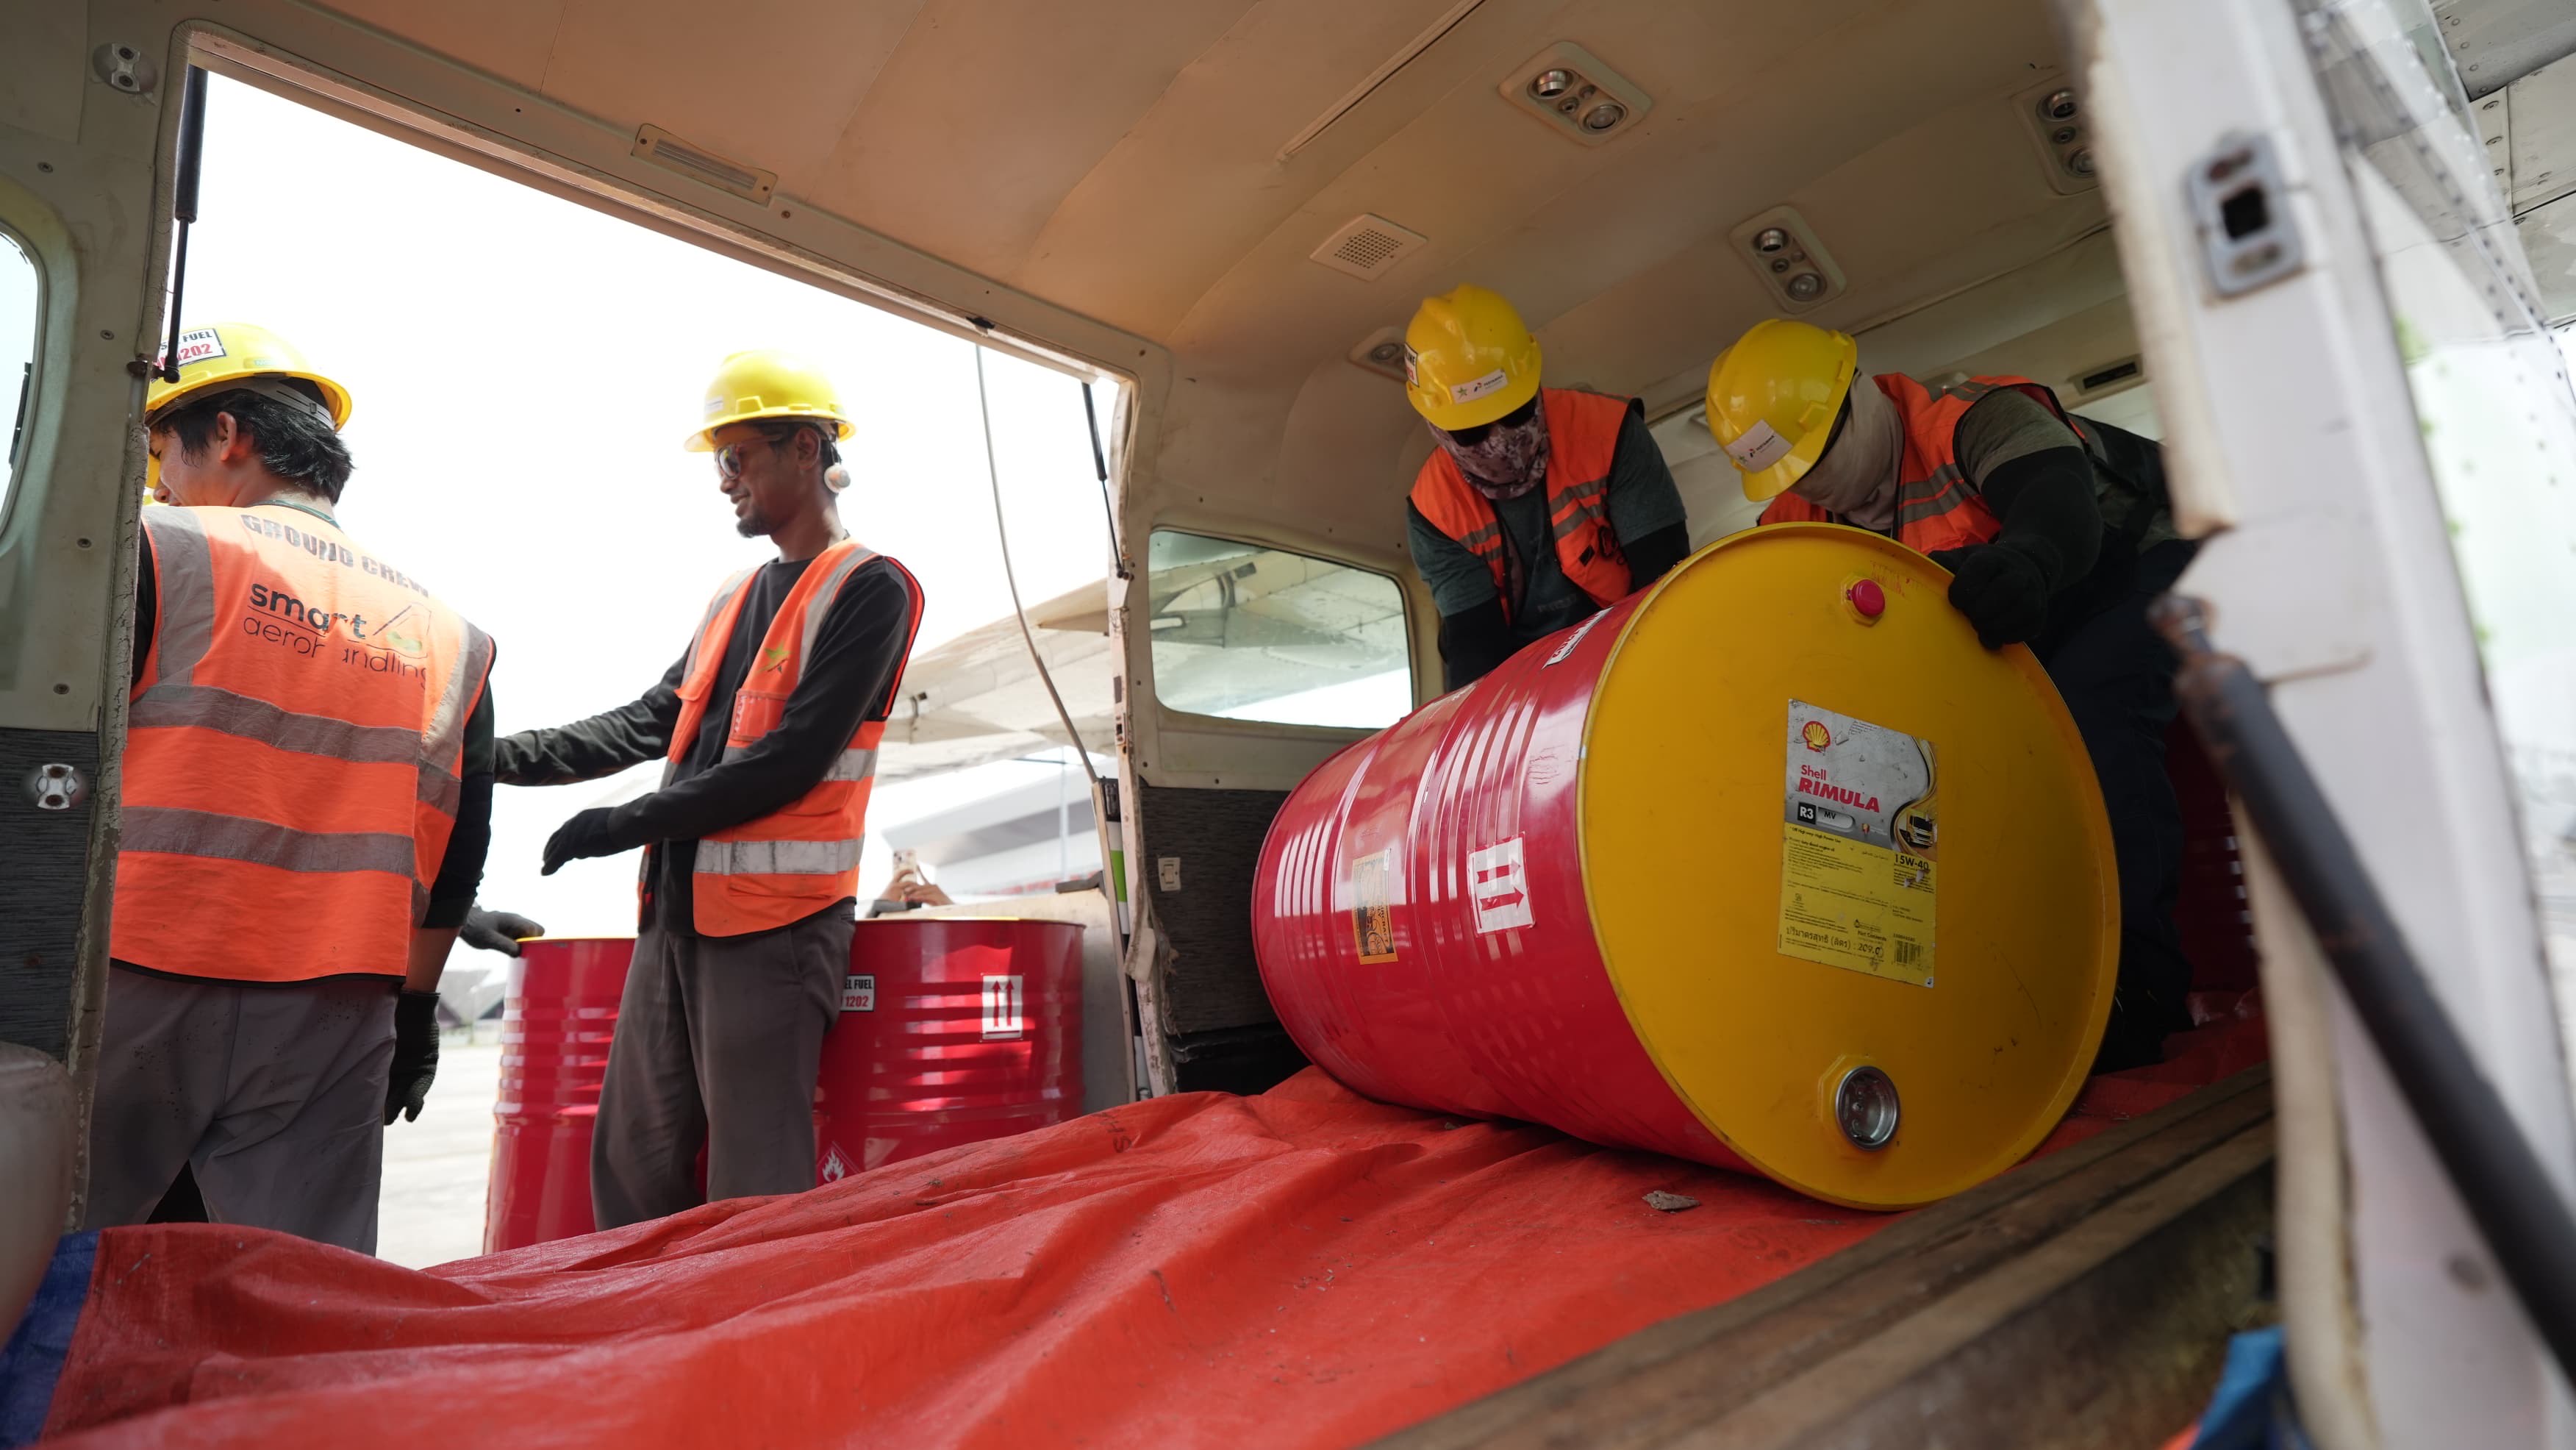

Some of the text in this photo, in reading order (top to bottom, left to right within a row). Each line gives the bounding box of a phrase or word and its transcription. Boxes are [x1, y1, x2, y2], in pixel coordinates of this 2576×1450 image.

[182, 331, 212, 343] FUEL
[240, 514, 429, 598] GROUND CREW
[249, 583, 367, 640] smart
[1801, 765, 1826, 781] Shell
[1798, 777, 1880, 813] RIMULA
[1800, 806, 1836, 821] R3 MV
[1895, 854, 1929, 870] 15W-40
[854, 979, 873, 989] FUEL
[846, 996, 869, 1007] 1202
